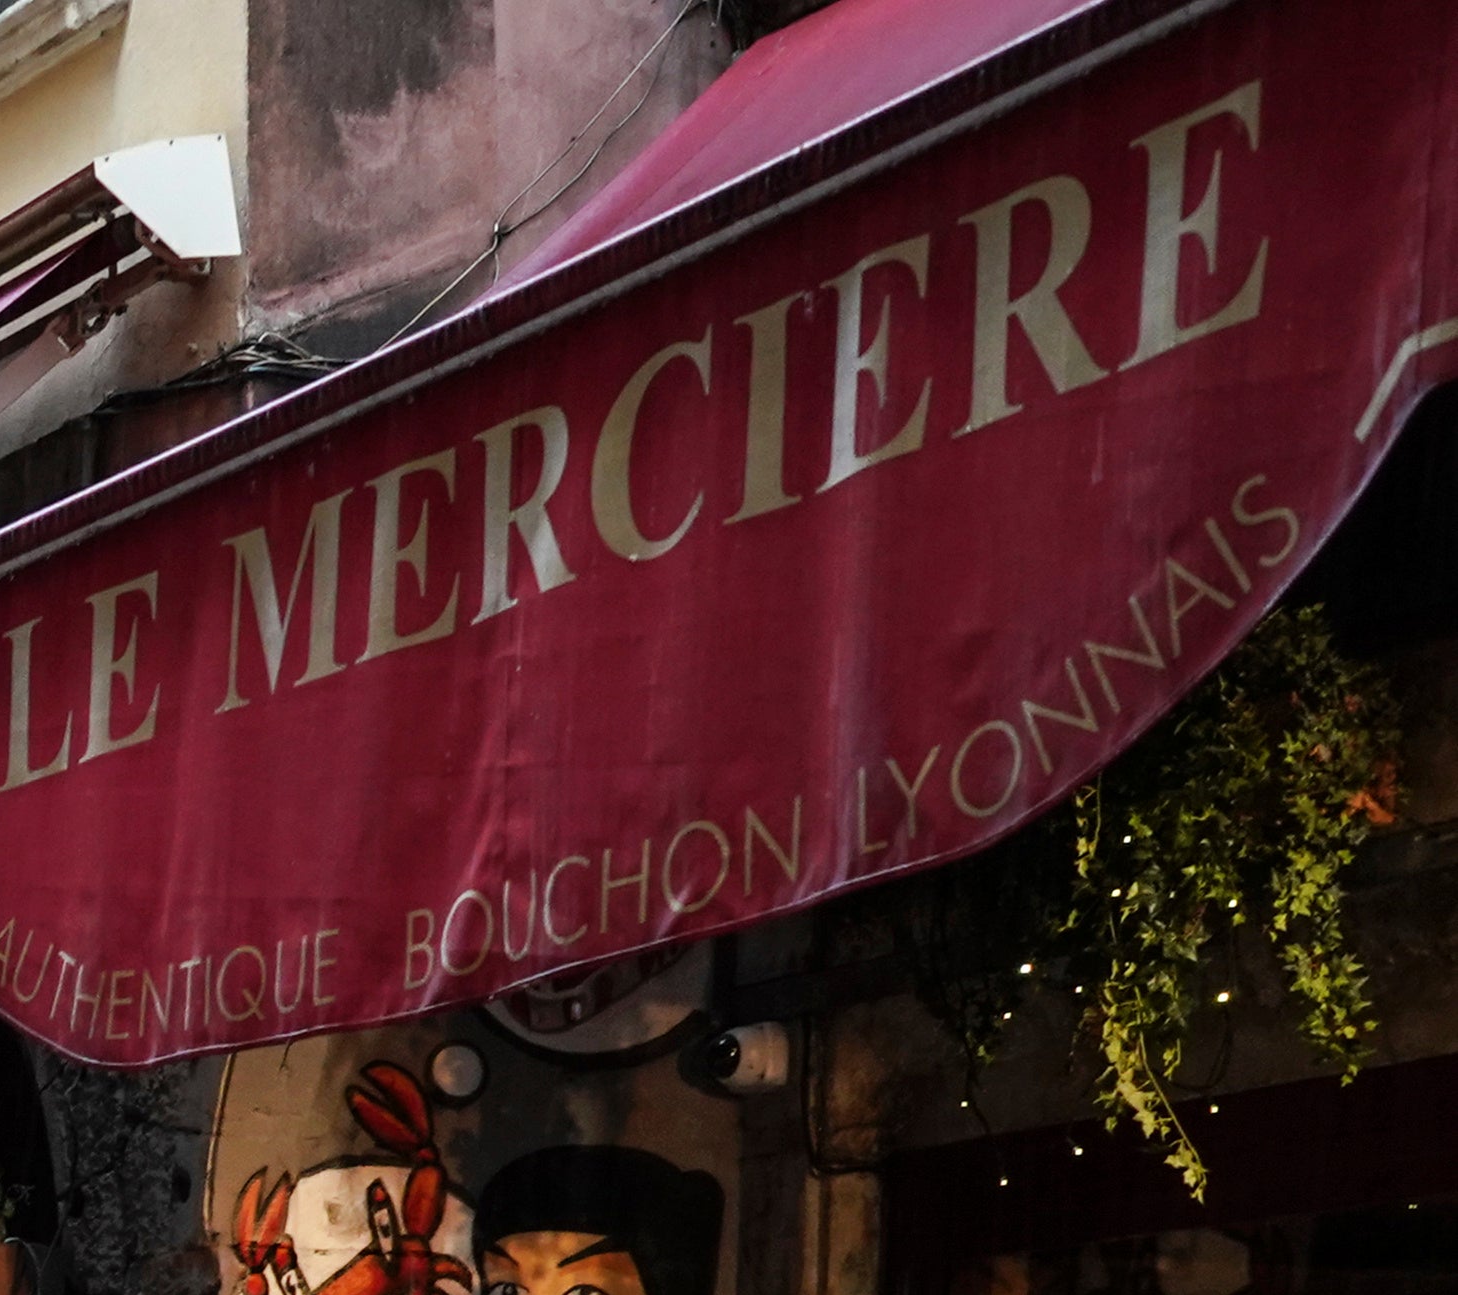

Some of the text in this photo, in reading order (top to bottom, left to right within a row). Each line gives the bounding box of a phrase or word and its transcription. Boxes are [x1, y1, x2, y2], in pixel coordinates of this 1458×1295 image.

[214, 78, 1271, 715] MERCIERE
[404, 796, 803, 992] BOUCHON
[856, 472, 1302, 857] LYONNAIS
